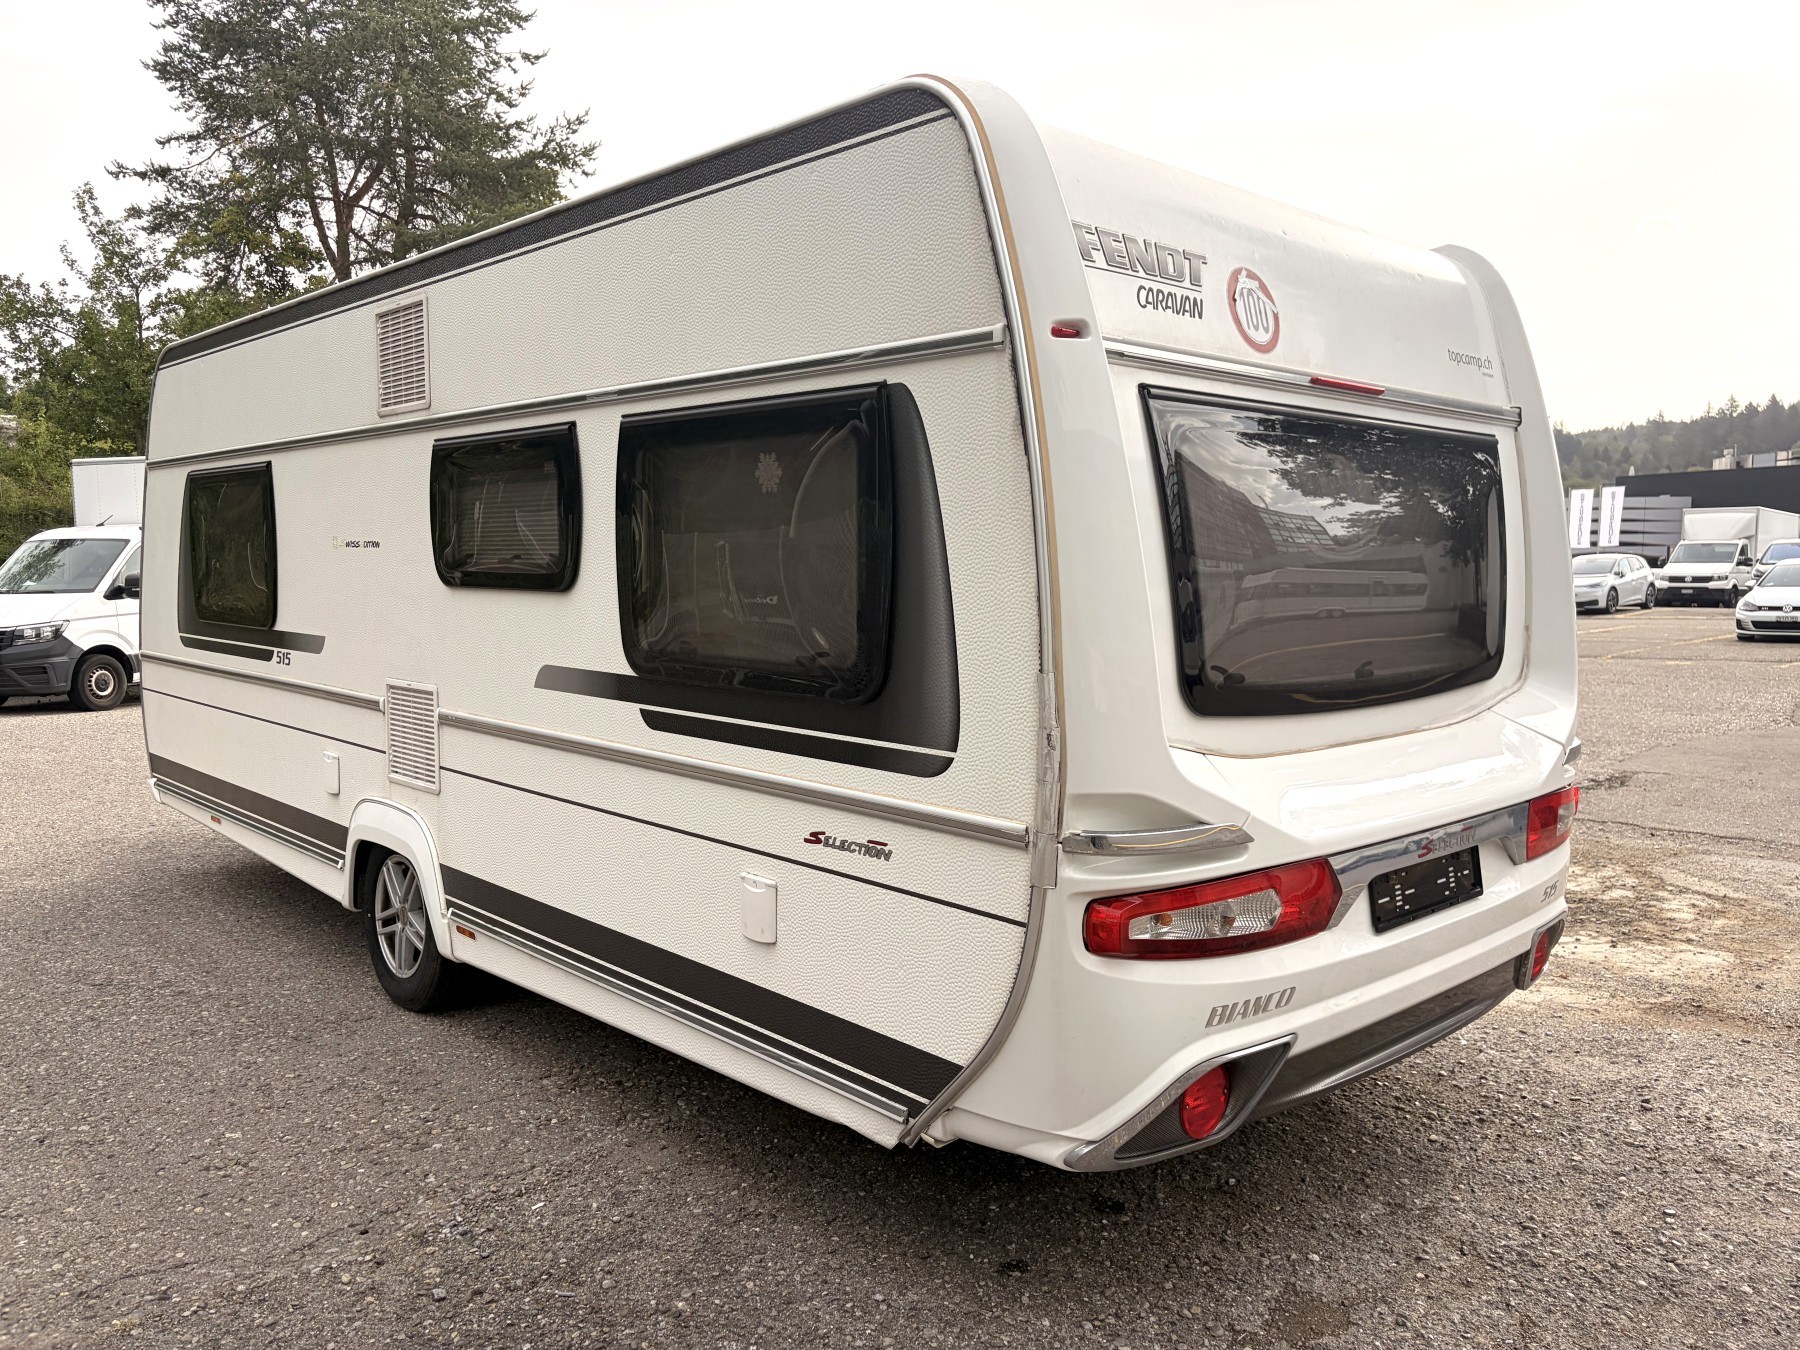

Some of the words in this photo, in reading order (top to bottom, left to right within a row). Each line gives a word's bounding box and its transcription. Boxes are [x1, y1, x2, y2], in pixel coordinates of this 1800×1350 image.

[1071, 220, 1208, 287] FENDT
[1137, 285, 1204, 319] CARAVAN
[1239, 284, 1270, 335] 100
[1447, 348, 1493, 371] topcamp.ch
[276, 650, 291, 667] 515
[1540, 879, 1560, 904] 515
[1205, 986, 1297, 1030] BIANCO
